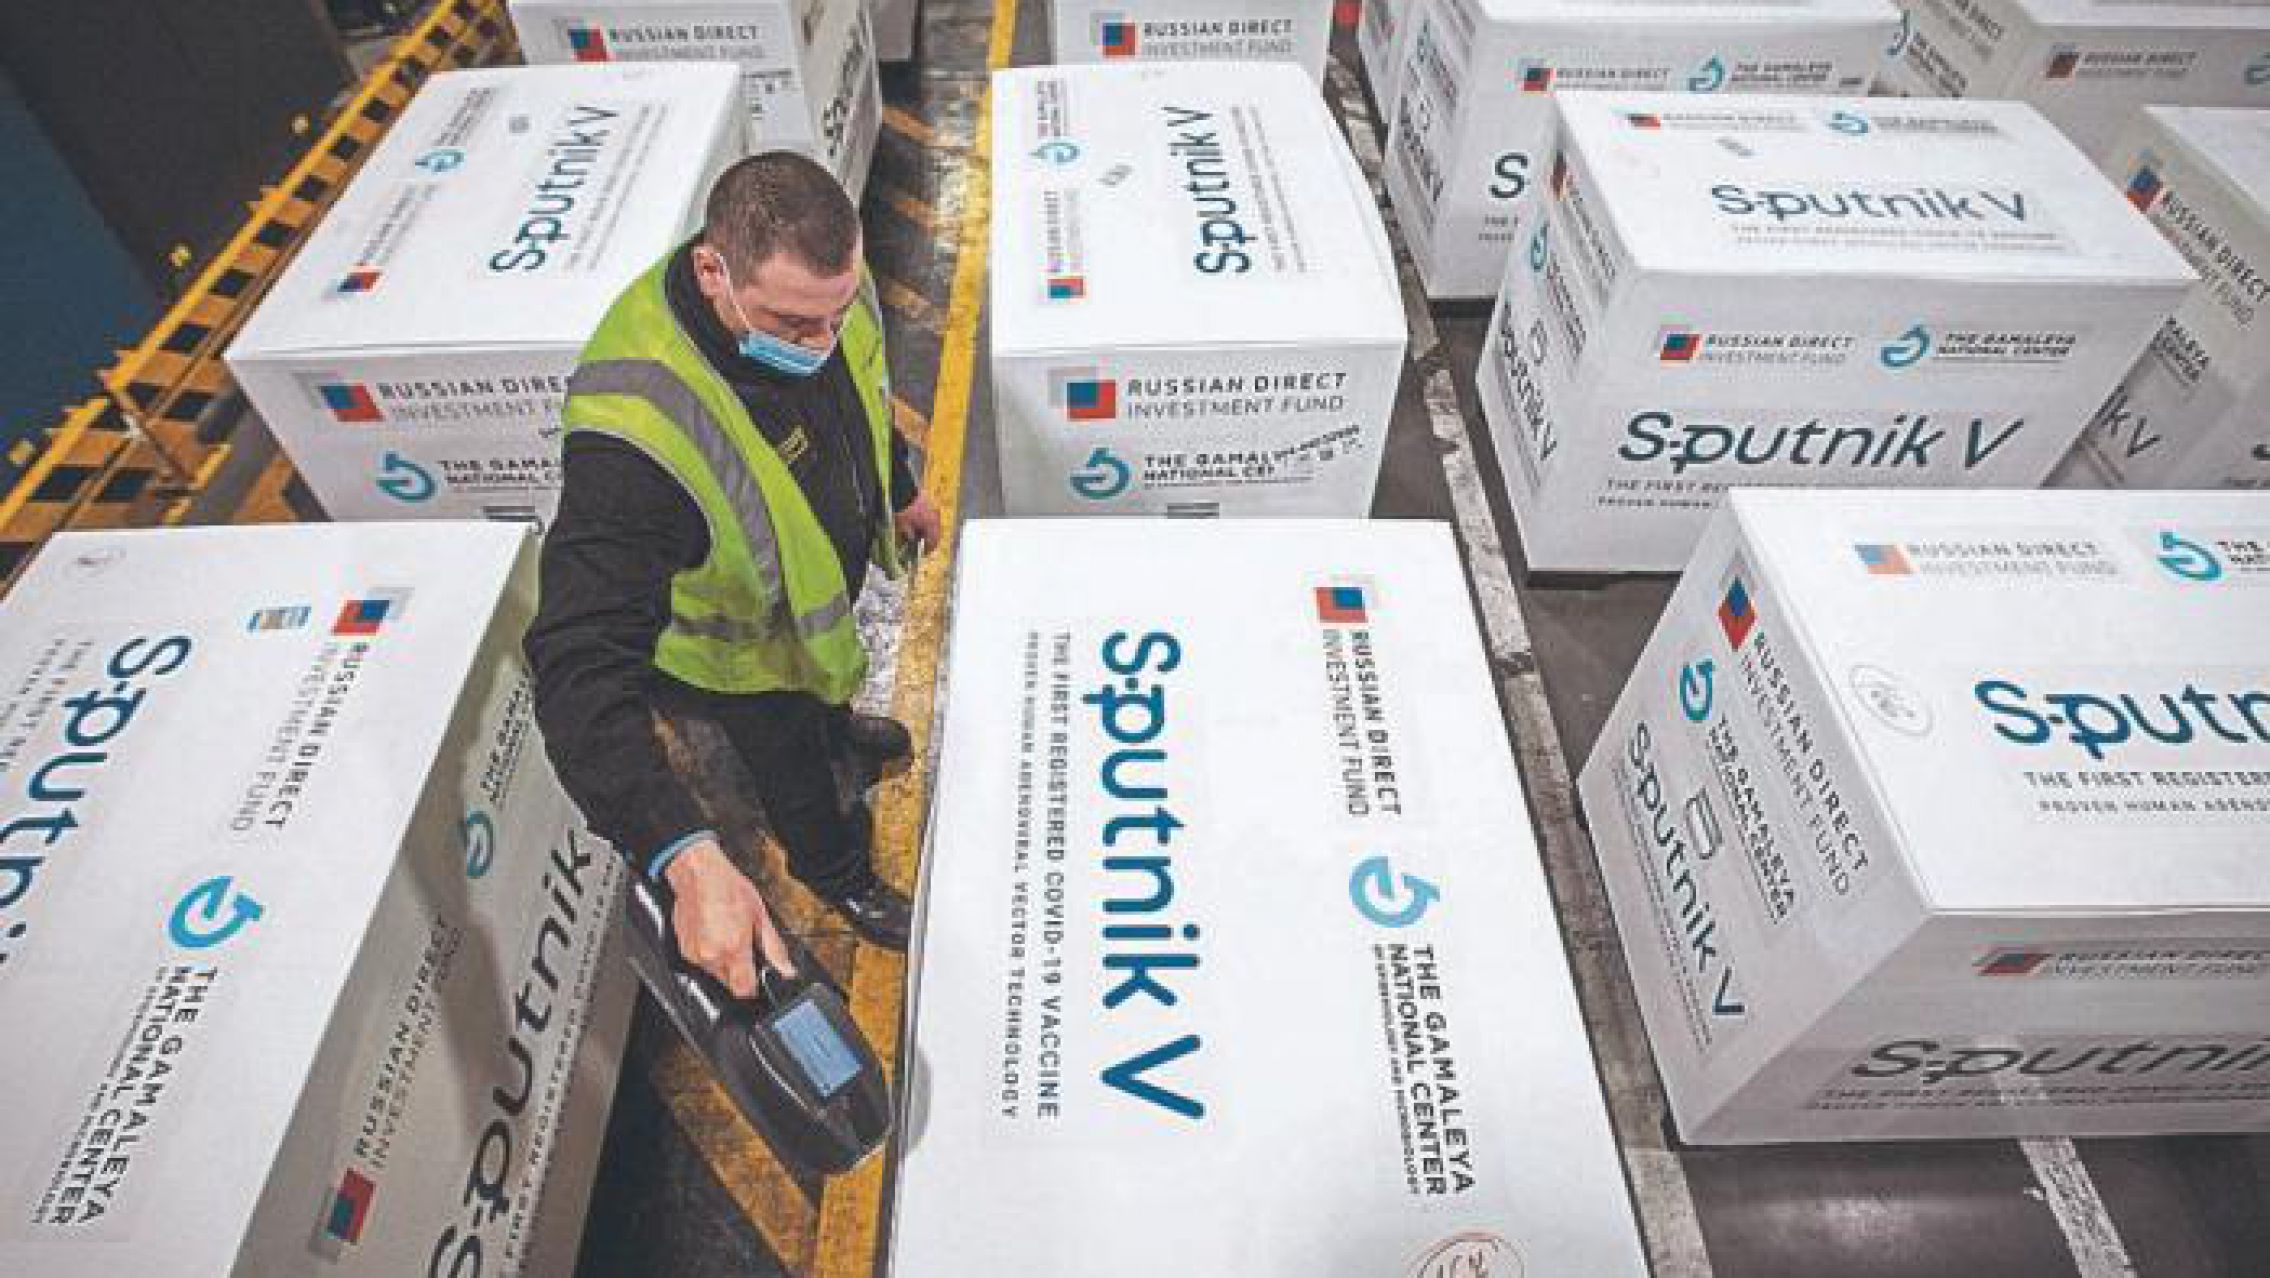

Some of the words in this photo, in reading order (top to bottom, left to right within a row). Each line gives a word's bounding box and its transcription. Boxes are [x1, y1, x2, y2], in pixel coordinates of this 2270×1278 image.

[693, 25, 759, 41] DIRECT
[1144, 21, 1223, 35] RUSSIAN
[1228, 19, 1292, 33] DIRECT
[1162, 106, 1214, 128] V
[489, 129, 611, 272] Sputnik
[567, 105, 619, 127] V
[1167, 133, 1258, 274] Sputnik
[1711, 184, 1981, 222] Sputnik
[1979, 190, 2026, 221] V
[1128, 377, 1243, 397] RUSSIAN
[1254, 372, 1347, 393] DIRECT
[1708, 335, 1784, 348] RUSSIAN
[1789, 335, 1854, 348] DIRECT
[377, 376, 494, 400] RUSSIAN
[1128, 399, 1275, 419] INVESTMENT
[1283, 395, 1345, 413] FUND
[438, 459, 483, 471] THE
[1143, 467, 1237, 481] NATIONAL
[1144, 453, 1187, 468] THE
[1617, 411, 1945, 475] Sputnik
[1964, 417, 2026, 471] V
[308, 642, 370, 736] RUSSIAN
[1053, 631, 1071, 665] THE
[1322, 628, 1362, 750] INVESTMENT
[1351, 631, 1385, 722] RUSSIAN
[1049, 673, 1071, 724] FIRST
[264, 743, 321, 831] DIRECT
[1341, 755, 1370, 818] FUND
[1367, 729, 1402, 815] DIRECT
[1752, 631, 1814, 754] RUSSIAN
[1808, 757, 1869, 873] DIRECT
[2023, 771, 2073, 789] THE
[2076, 771, 2144, 787] FIRST
[1047, 732, 1069, 861] REGISTERED
[1082, 631, 1201, 1010] Sputnik
[1627, 721, 1718, 973] Sputnik
[1712, 964, 1745, 1018] V
[1809, 812, 1851, 897] FUND
[1010, 881, 1029, 959] VECTOR
[1043, 871, 1065, 985] COVID-19
[176, 966, 218, 1024] THE
[1411, 943, 1442, 1001] THE
[112, 966, 192, 1100] NATIONAL
[353, 1019, 411, 1158] RUSSIAN
[404, 913, 446, 1015] DIRECT
[1001, 968, 1026, 1120] TECHNOLOGY
[1037, 995, 1062, 1120] VACCINE
[1387, 943, 1426, 1075] NATIONAL
[1409, 1081, 1448, 1196] CENTER
[1100, 1033, 1205, 1120] V
[1423, 1010, 1476, 1195] GAMALEYA
[50, 1108, 122, 1225] CENTER
[77, 1034, 184, 1225] GAMALEYA
